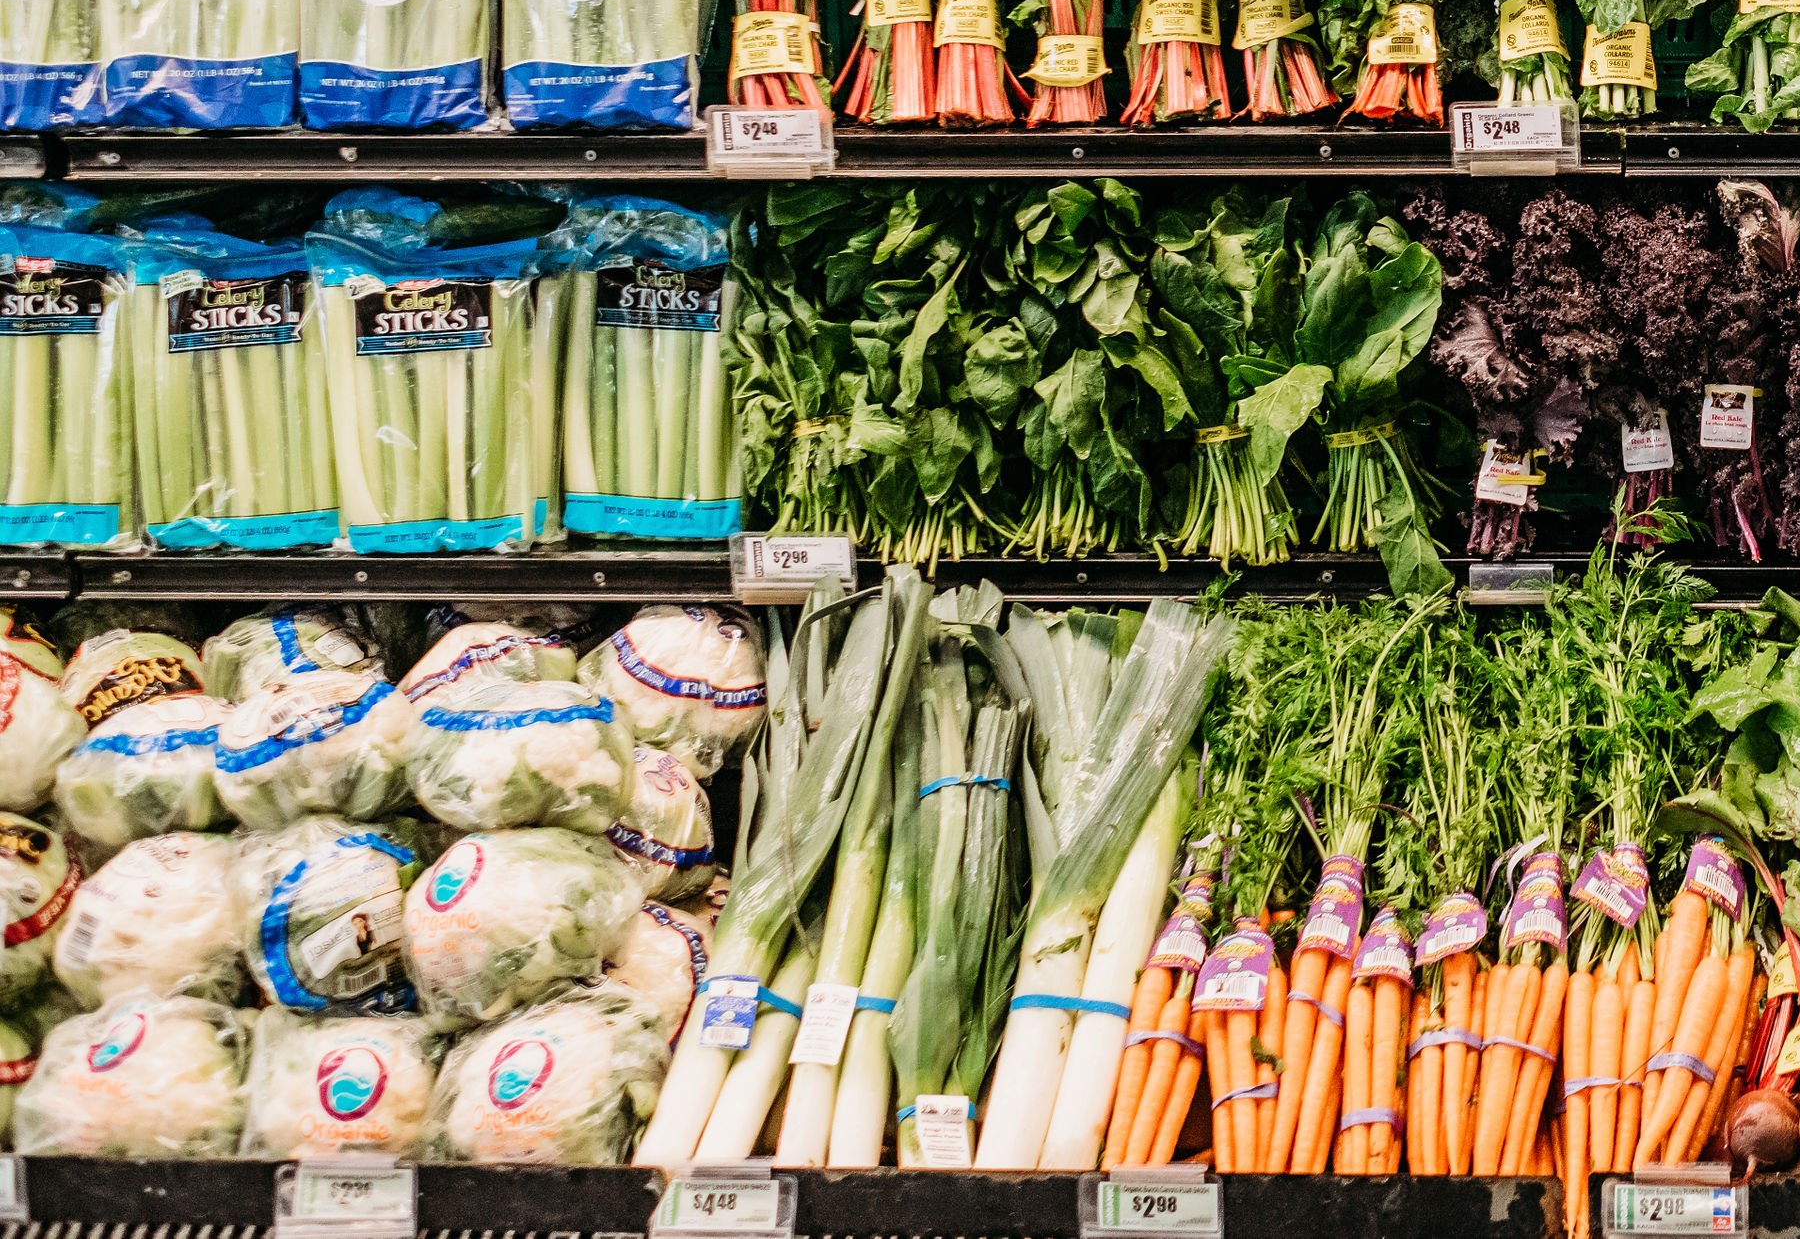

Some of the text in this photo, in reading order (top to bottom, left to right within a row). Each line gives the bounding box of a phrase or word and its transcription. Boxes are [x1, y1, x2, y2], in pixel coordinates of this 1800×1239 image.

[976, 4, 989, 12] RED
[1155, 1, 1182, 9] ORGANIC
[1245, 5, 1284, 14] ORGANIC RED
[967, 11, 989, 20] CHARD
[1155, 8, 1194, 17] SWISS CHARD
[1245, 11, 1285, 21] SWISS CHARD
[1521, 13, 1549, 22] ORGANIC
[1521, 20, 1550, 30] COLLARDS
[1527, 29, 1549, 38] 94614
[1612, 28, 1637, 40] Farms
[1605, 44, 1633, 52] ORGANIC
[1603, 50, 1634, 59] COLLARDS
[1066, 58, 1079, 66] RED
[1607, 59, 1630, 68] 94614
[1058, 65, 1080, 73] CHARD
[132, 70, 197, 79] NET OZ
[322, 78, 338, 87] NET
[368, 80, 378, 89] OZ
[571, 76, 583, 84] OZ
[743, 121, 779, 141] $248
[1483, 120, 1522, 141] $248
[635, 268, 686, 294] Celery
[202, 283, 266, 307] Celery
[619, 287, 701, 312] STICKS
[385, 288, 455, 314] Celery
[190, 303, 282, 333] STICKS
[373, 308, 469, 335] STICKS
[1711, 414, 1744, 423] Red Kale
[1630, 436, 1646, 445] Red
[1490, 466, 1505, 474] Red
[773, 550, 809, 569] $298
[409, 911, 481, 939] Organic
[296, 1113, 392, 1145] Organic
[693, 1192, 738, 1216] $448
[1132, 1194, 1178, 1219] $298
[1639, 1197, 1685, 1222] $298
